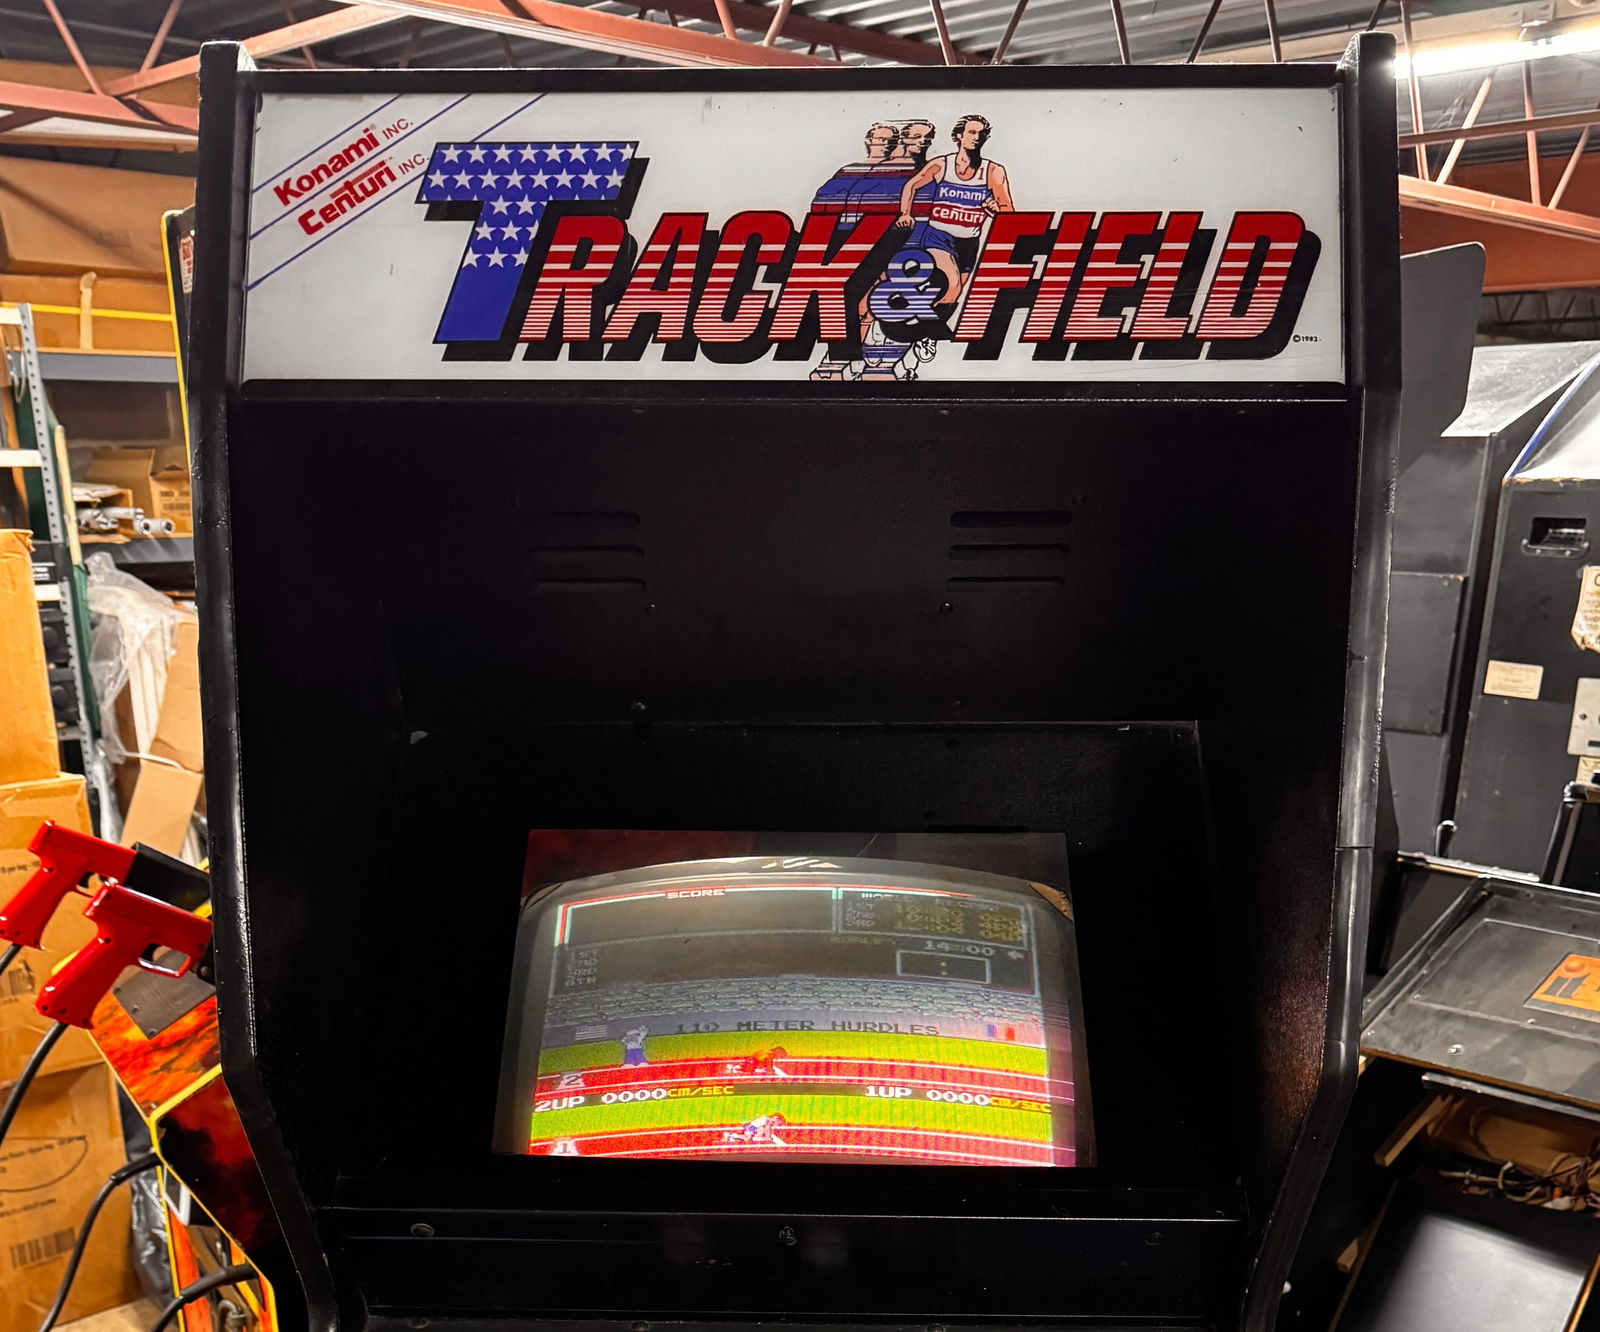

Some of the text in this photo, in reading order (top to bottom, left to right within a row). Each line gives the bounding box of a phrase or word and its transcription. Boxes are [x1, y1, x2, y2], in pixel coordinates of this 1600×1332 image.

[273, 118, 413, 207] Konami INC.
[939, 187, 986, 201] Konami
[414, 141, 1310, 350] TRACK & FIELD
[666, 887, 726, 900] SCORE
[736, 1018, 815, 1033] METER
[830, 1020, 940, 1037] HURDLES
[535, 1085, 735, 1112] 2UP 0000 CM/SEC
[865, 1085, 913, 1099] 1UP
[926, 1089, 990, 1106] 0000
